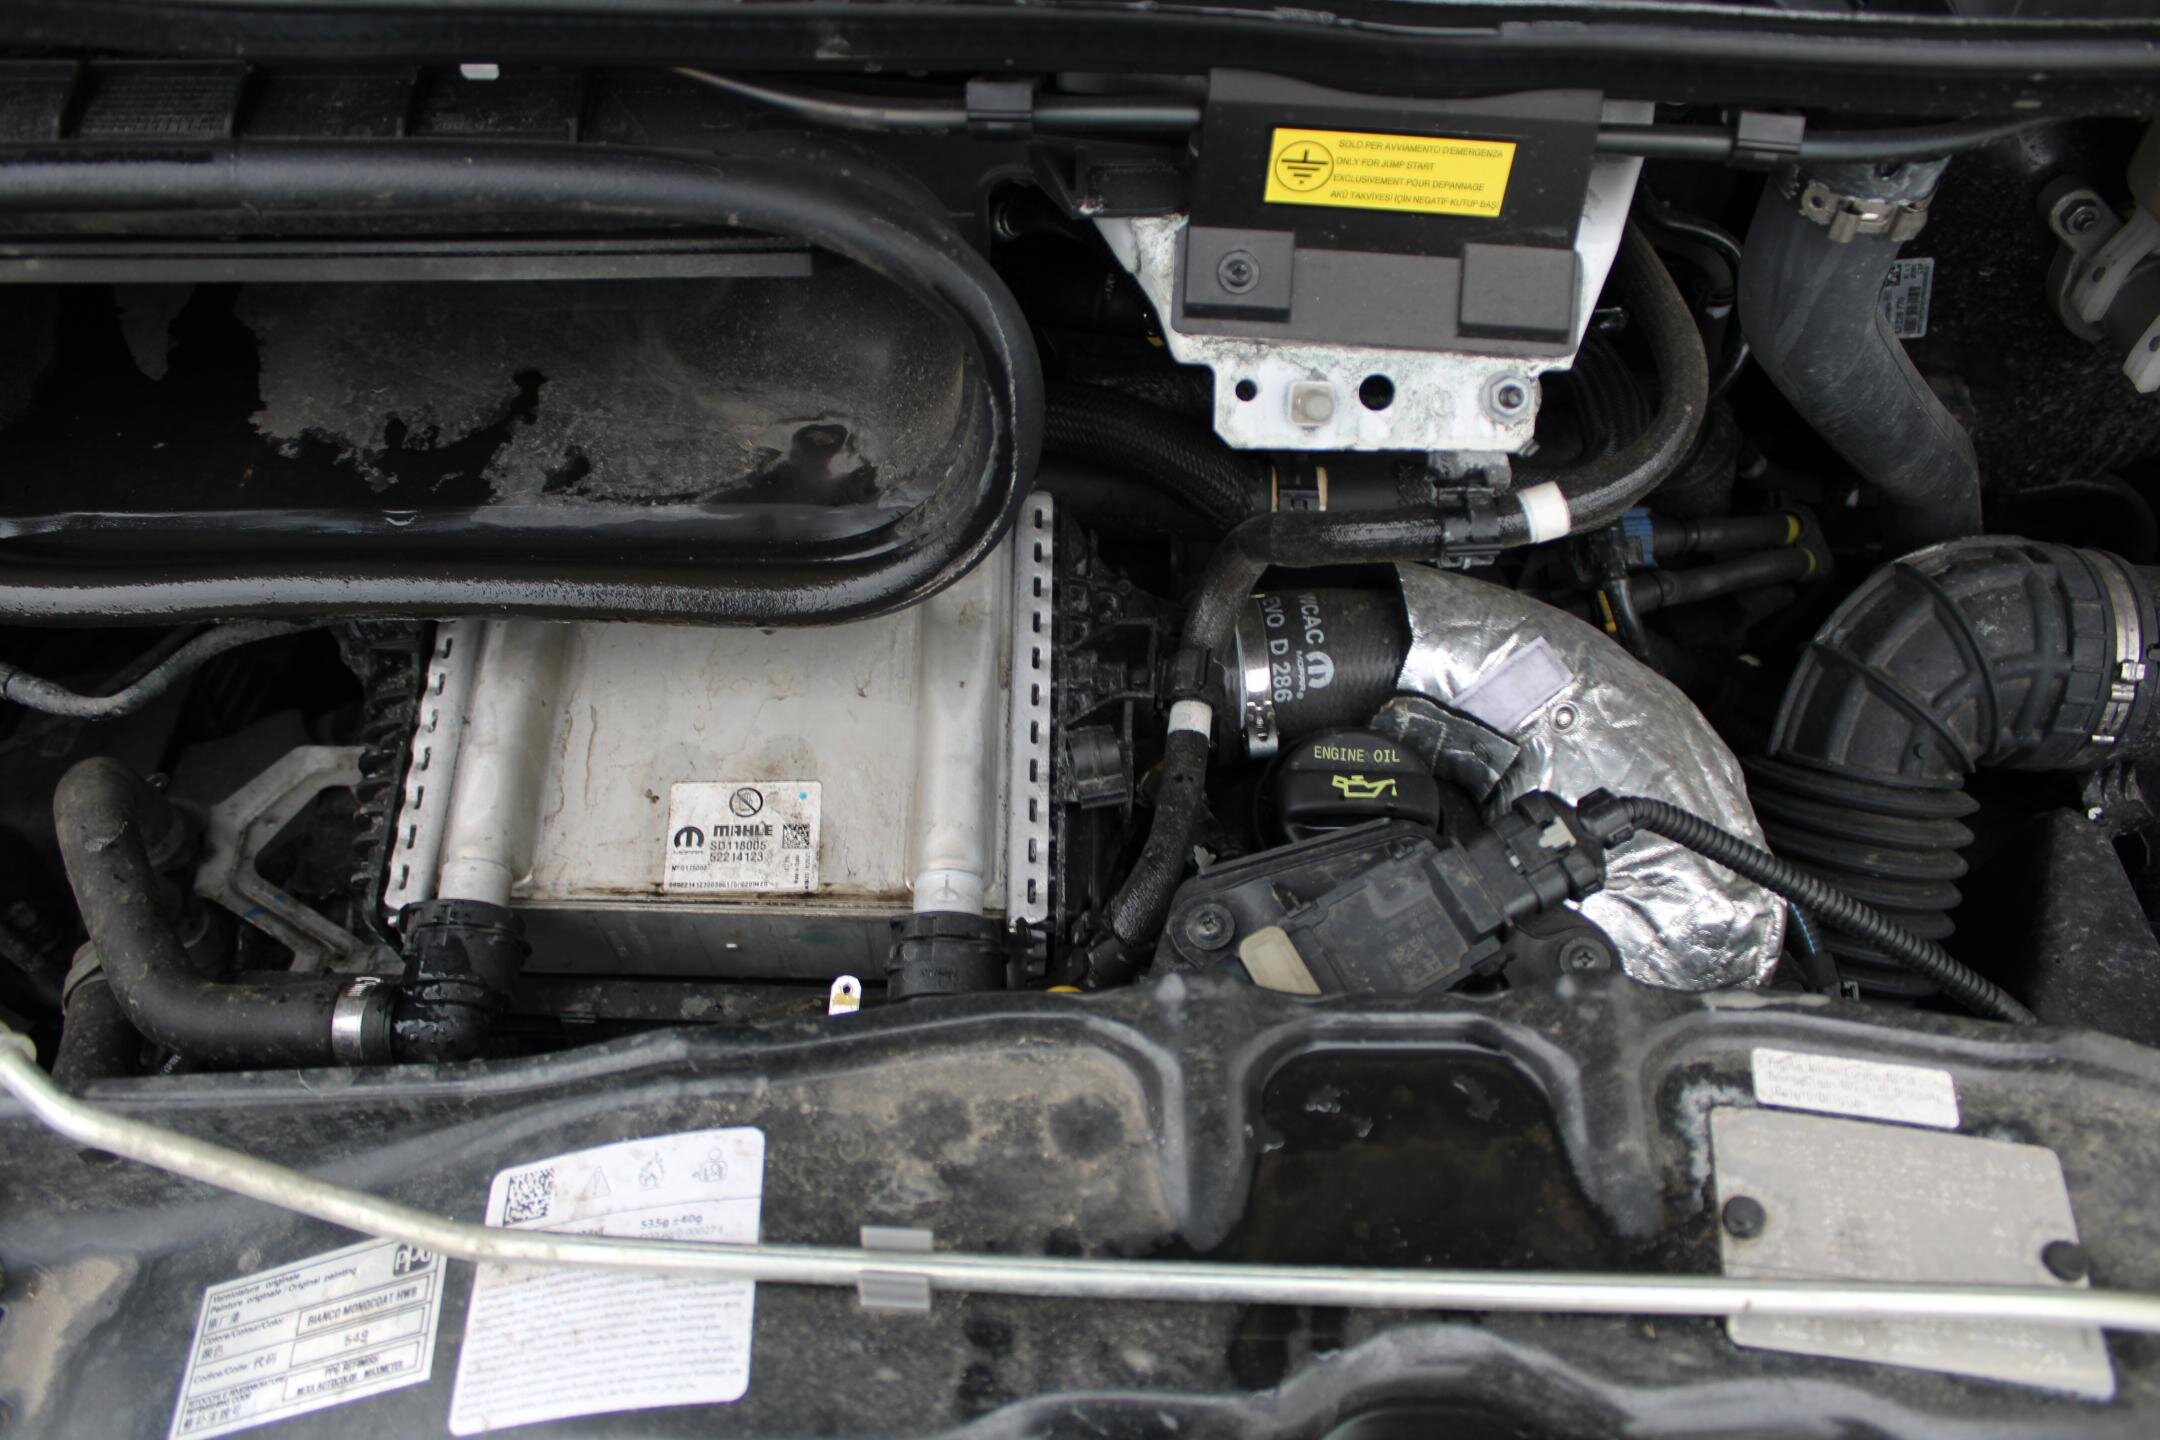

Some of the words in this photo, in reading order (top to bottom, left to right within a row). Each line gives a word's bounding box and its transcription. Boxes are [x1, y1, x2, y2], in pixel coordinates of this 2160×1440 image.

[1338, 139, 1363, 149] SOLO
[1365, 141, 1382, 150] PER
[1384, 142, 1440, 153] AVVIAMENTO
[1442, 145, 1503, 158] D'EMERGENZA
[1336, 156, 1360, 166] ONLY
[1362, 157, 1379, 167] FOR
[1381, 159, 1405, 169] JUMP
[1406, 161, 1434, 171] START
[1333, 174, 1404, 186] EXCLUSIVEMENT
[1406, 178, 1430, 188] POUR
[1432, 180, 1485, 191] DEPANNAGE
[1270, 638, 1289, 656] D
[1272, 661, 1293, 703] 286
[1313, 745, 1365, 763] ENGINE
[1373, 749, 1400, 763] OIL
[713, 824, 773, 837] MAHLE
[709, 840, 767, 851] SD118005
[709, 851, 764, 863] 52214123
